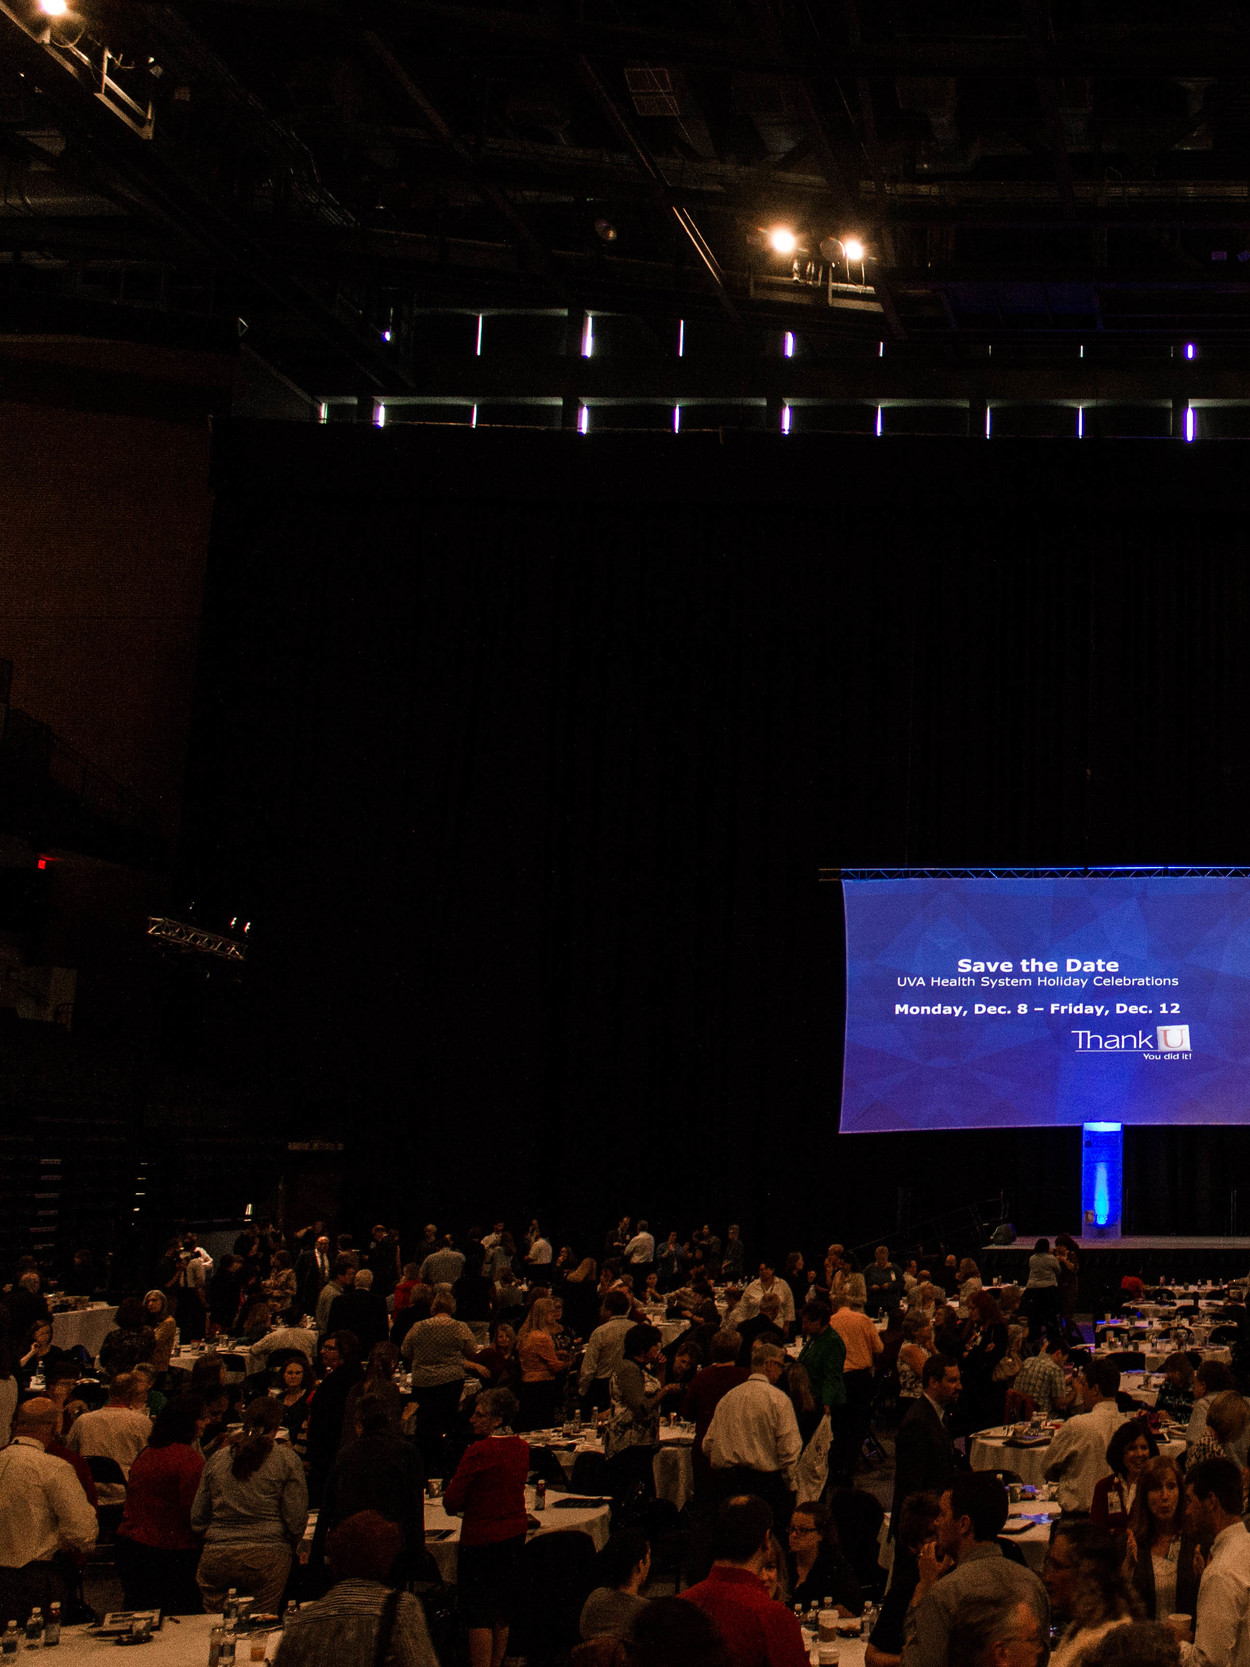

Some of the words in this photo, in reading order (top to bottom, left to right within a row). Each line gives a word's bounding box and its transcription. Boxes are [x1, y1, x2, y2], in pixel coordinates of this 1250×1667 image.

[957, 958, 1013, 973] Save
[1020, 958, 1058, 973] the
[1066, 958, 1119, 973] Date
[897, 976, 925, 986] UVA
[931, 976, 975, 986] Health
[980, 976, 1031, 988] System
[1038, 976, 1088, 988] Holiday
[1093, 976, 1179, 986] Celebrations
[895, 1003, 968, 1016] Monday,
[974, 1003, 1011, 1014] Dec.
[1017, 1003, 1028, 1014] 8
[1050, 1003, 1110, 1016] Friday,
[1116, 1003, 1152, 1014] Dec.
[1159, 1003, 1180, 1014] 12
[1071, 1029, 1153, 1049] Thank
[1160, 1029, 1186, 1048] U
